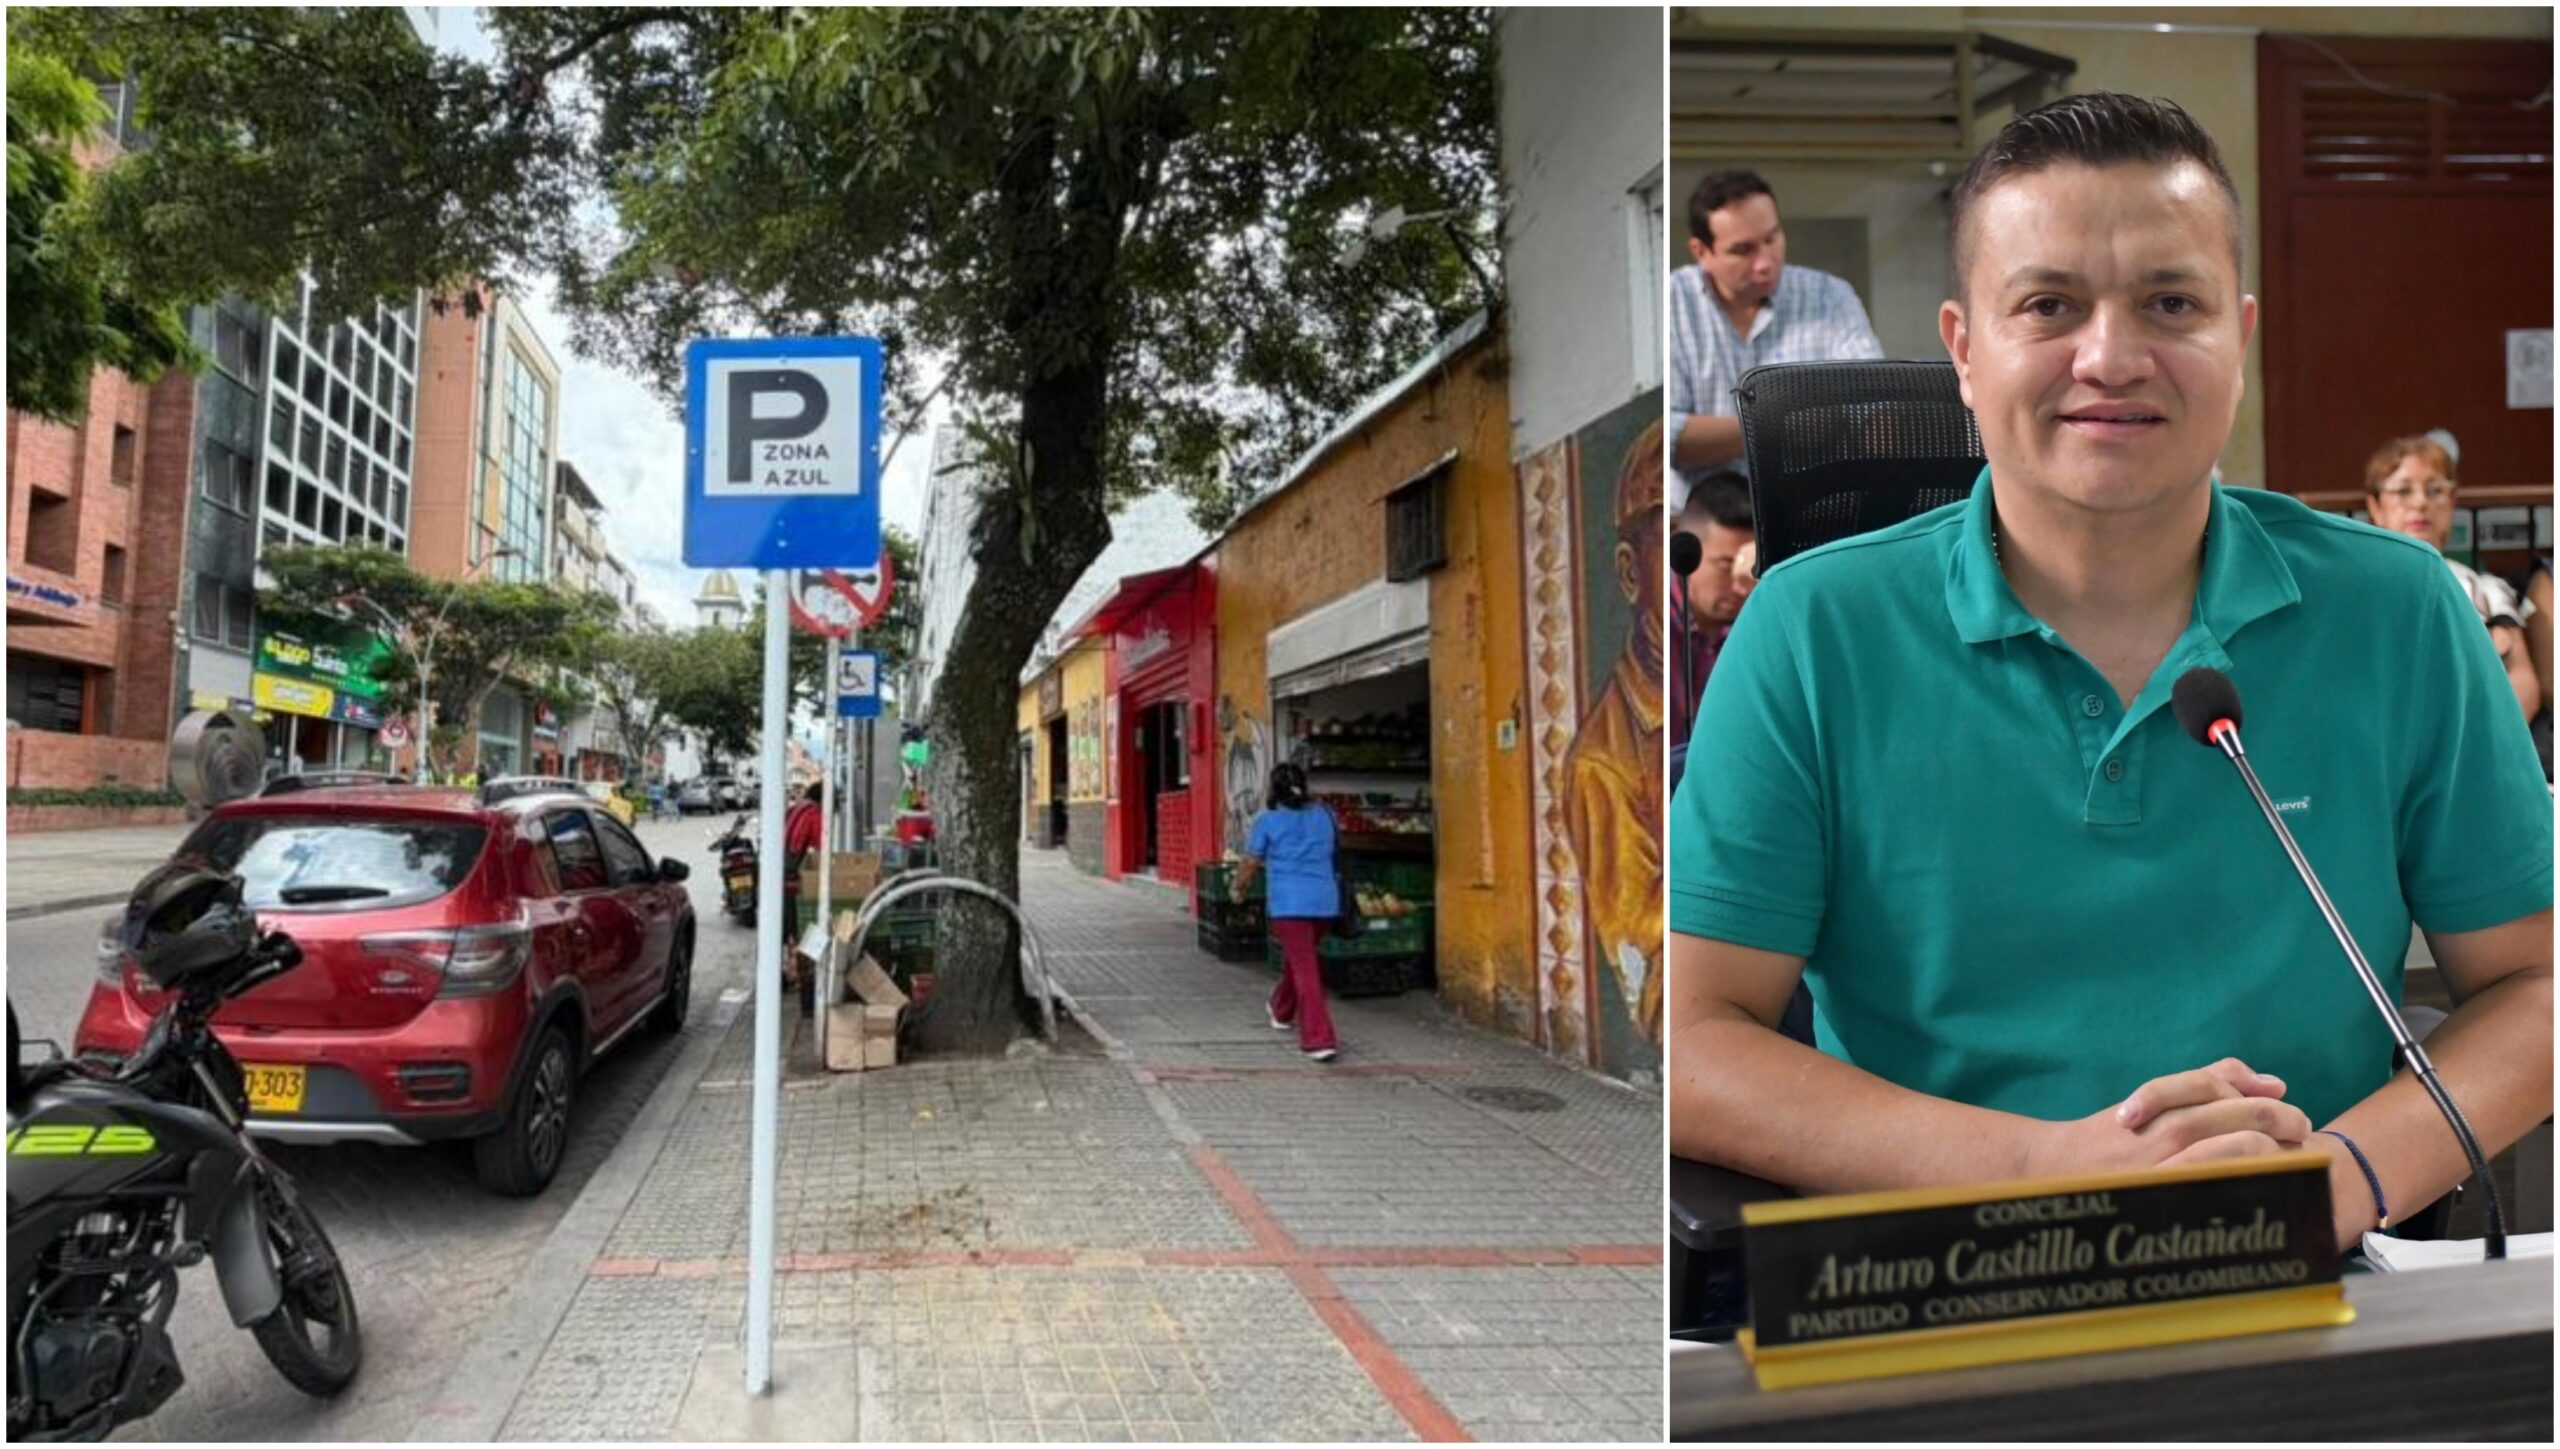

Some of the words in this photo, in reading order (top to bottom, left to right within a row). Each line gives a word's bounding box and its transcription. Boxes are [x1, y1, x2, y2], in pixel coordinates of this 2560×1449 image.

[728, 369, 829, 484] P
[763, 444, 831, 461] ZONA
[764, 469, 831, 486] AZUL
[1975, 1193, 2119, 1228] CONCEJAL
[1808, 1254, 1935, 1300] Arturo
[2104, 1207, 2288, 1267] Castañeda
[1788, 1302, 1910, 1337] PARTIDO
[1923, 1278, 2128, 1322] CONSERVADOR
[2132, 1260, 2309, 1298] COLOMBIANO
